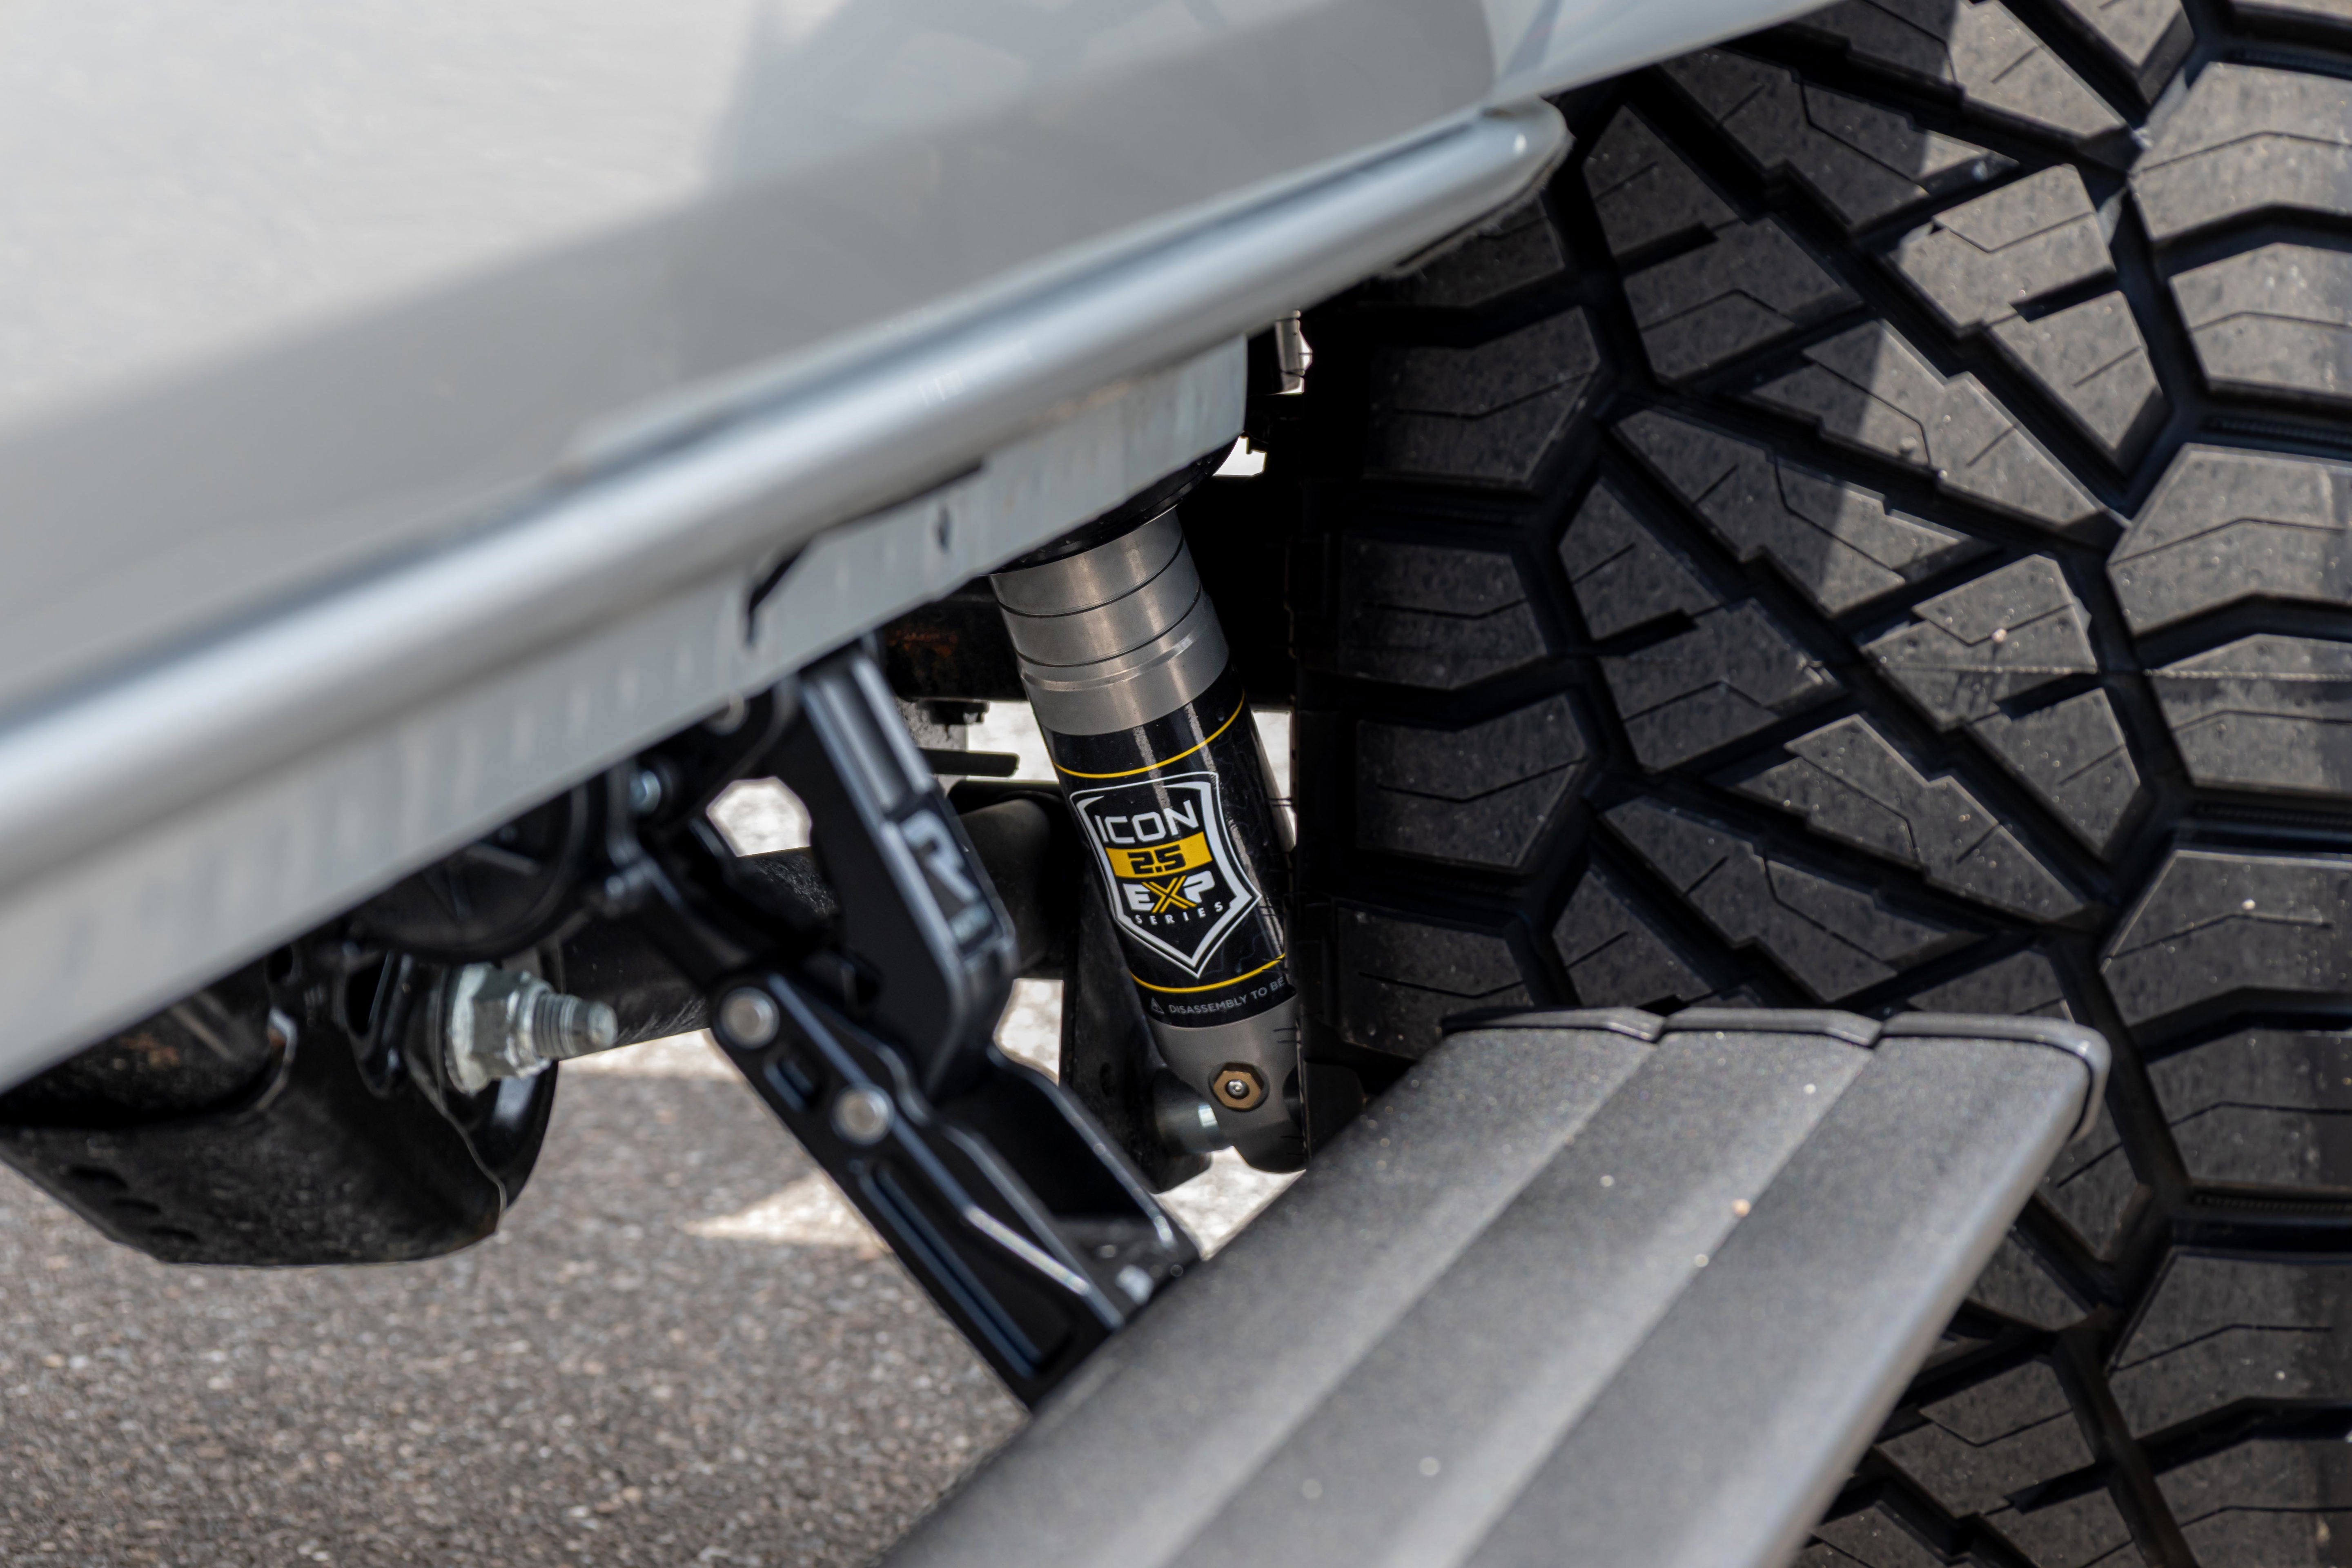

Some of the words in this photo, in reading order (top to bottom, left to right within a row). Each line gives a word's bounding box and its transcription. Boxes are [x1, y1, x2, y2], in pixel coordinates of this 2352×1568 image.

[1094, 800, 1199, 844] ICON
[1127, 844, 1187, 875] 2.5
[1122, 870, 1215, 913] EXP
[1134, 901, 1224, 926] SERIES
[1168, 994, 1247, 1015] DISASSEMBLY
[1250, 987, 1268, 1000] TO
[1269, 976, 1285, 992] BE
